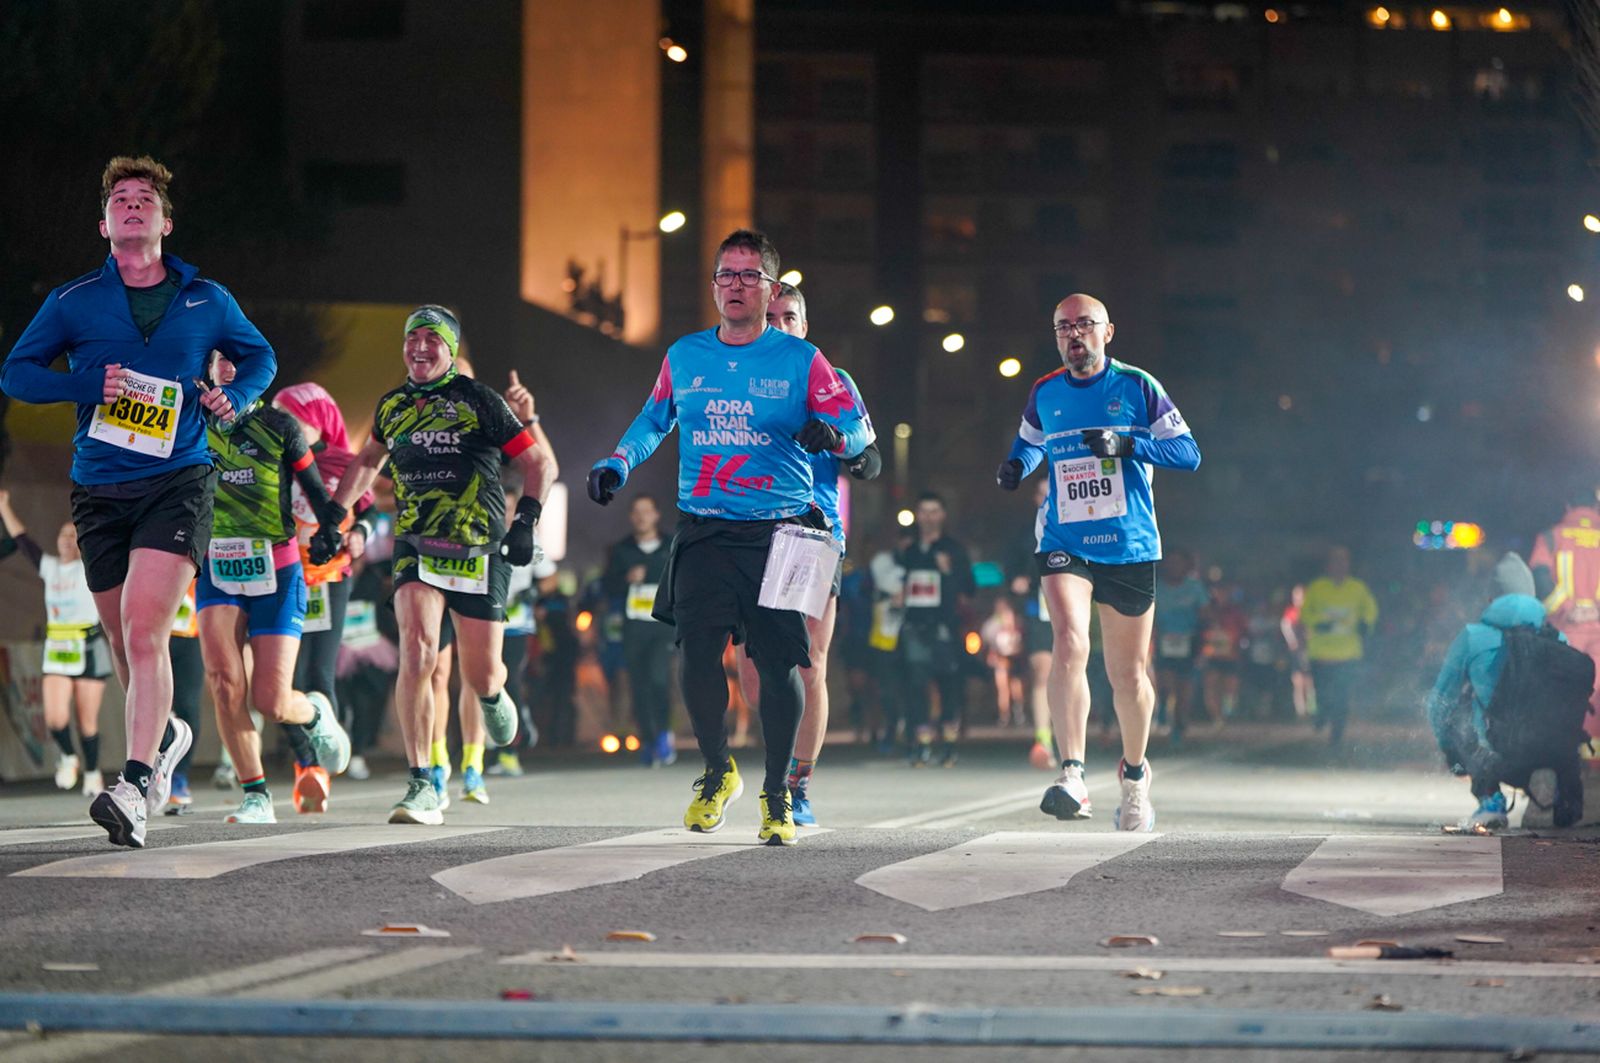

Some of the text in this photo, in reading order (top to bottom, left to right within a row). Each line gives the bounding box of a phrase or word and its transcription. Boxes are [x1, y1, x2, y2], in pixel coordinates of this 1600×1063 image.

[146, 386, 157, 394] DE
[109, 396, 170, 431] 13024
[704, 399, 755, 416] ADRA
[706, 415, 752, 431] TRAIL
[411, 431, 461, 447] eyas
[692, 430, 772, 446] RUNNING
[427, 446, 462, 454] TRAIL
[222, 468, 254, 483] eyas
[1068, 465, 1087, 473] NOCHE
[1063, 474, 1075, 482] SAN
[1067, 477, 1112, 501] 6069
[216, 556, 266, 577] 12039
